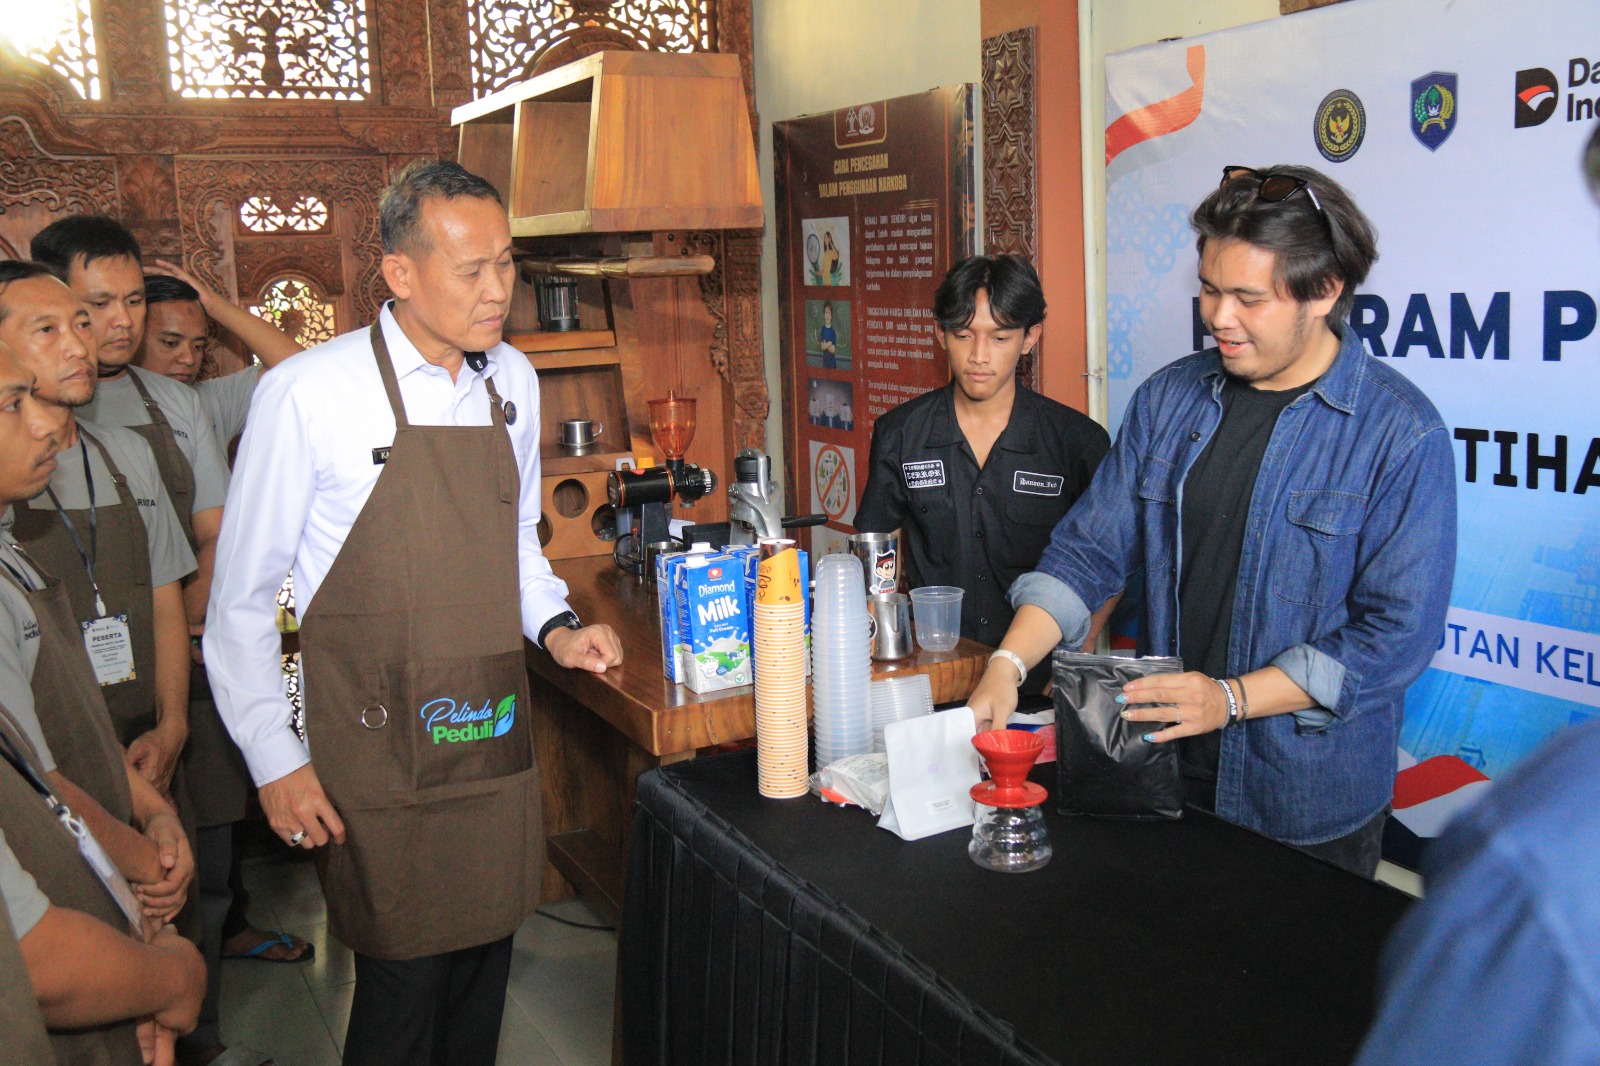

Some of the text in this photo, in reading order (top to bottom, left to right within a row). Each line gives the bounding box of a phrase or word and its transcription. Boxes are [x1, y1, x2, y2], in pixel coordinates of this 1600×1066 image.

[833, 152, 888, 175] CARA PENCEGAHAN
[818, 174, 908, 198] DALAM PENGGUNAAN NARKOBA
[698, 580, 735, 598] Diamond
[697, 595, 741, 626] Milk
[92, 632, 123, 643] PESERTA
[432, 720, 494, 745] Peduli
